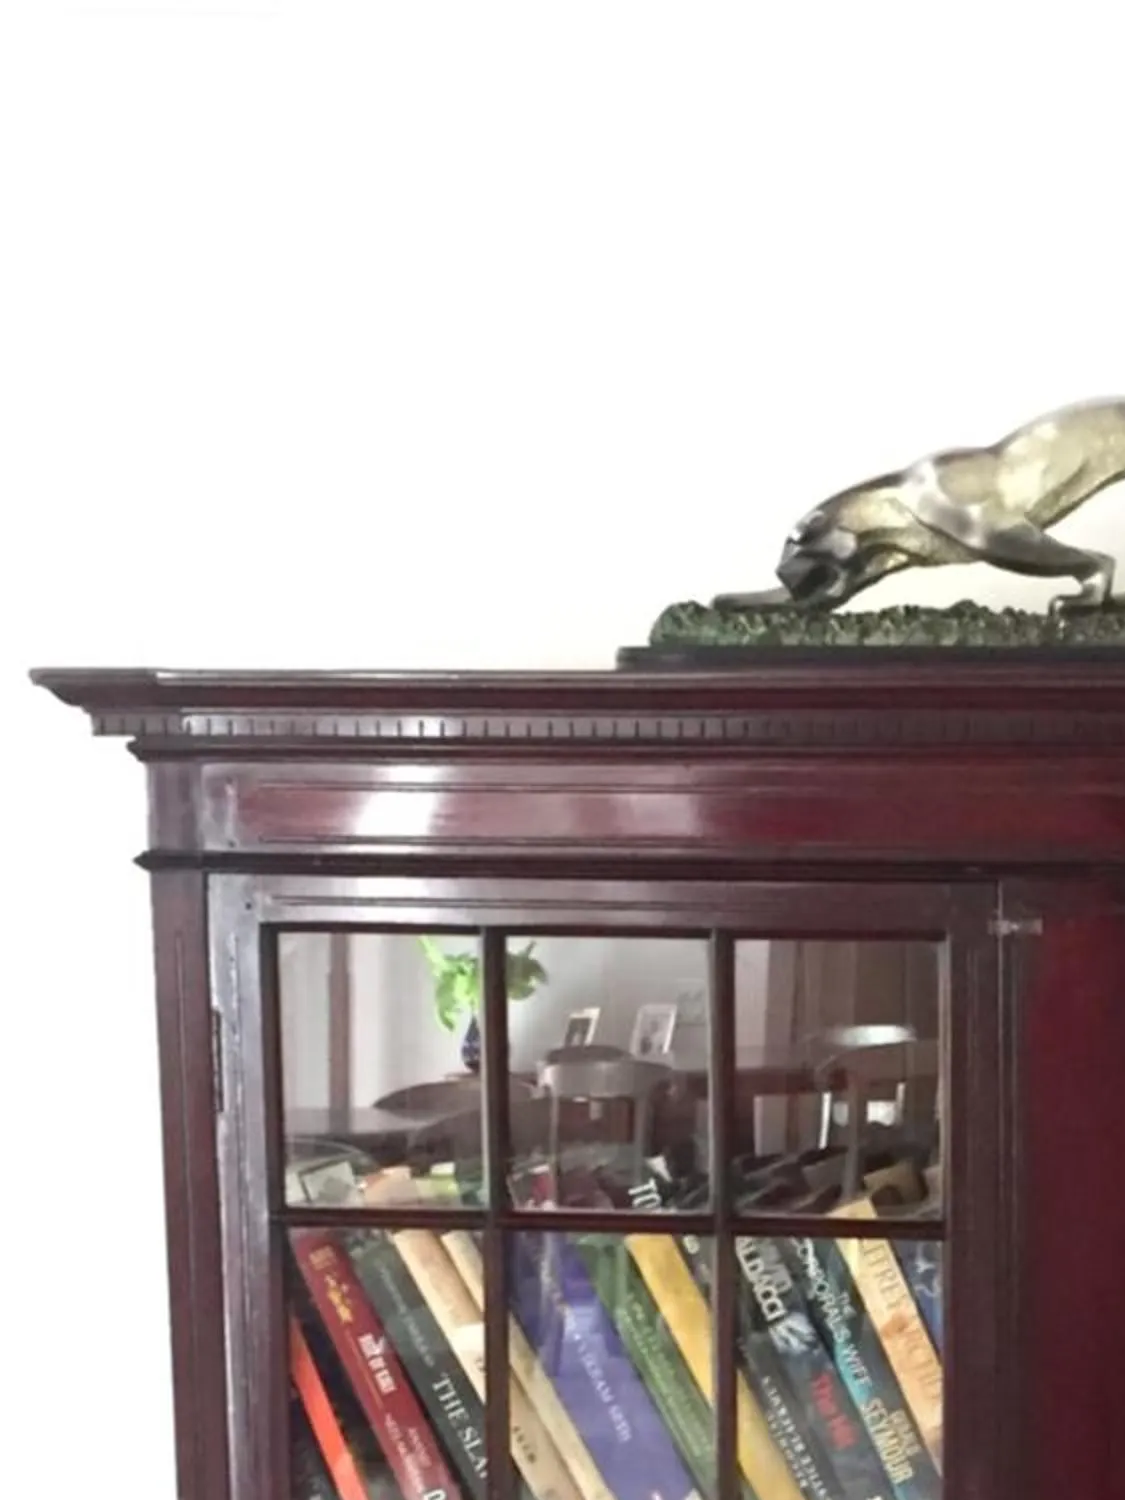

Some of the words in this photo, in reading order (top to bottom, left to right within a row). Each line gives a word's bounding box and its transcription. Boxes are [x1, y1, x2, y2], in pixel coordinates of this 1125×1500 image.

[429, 1372, 470, 1429] THE
[455, 1423, 497, 1481] SLA
[861, 1398, 916, 1484] SEYMOUR
